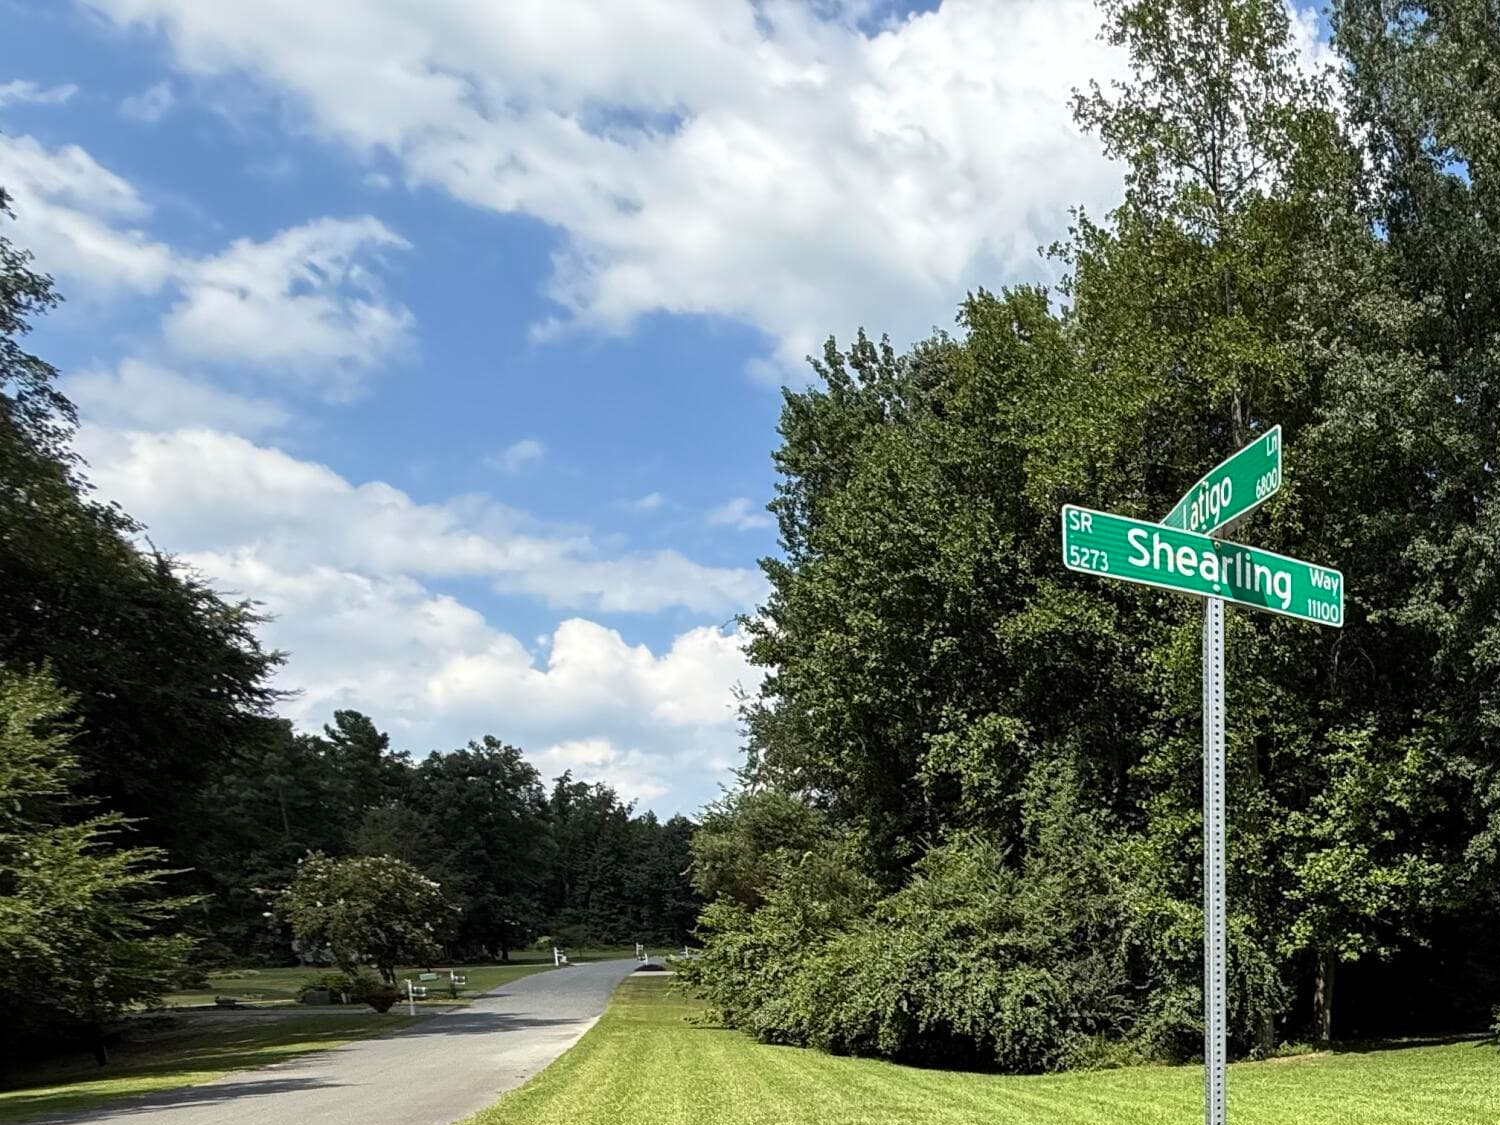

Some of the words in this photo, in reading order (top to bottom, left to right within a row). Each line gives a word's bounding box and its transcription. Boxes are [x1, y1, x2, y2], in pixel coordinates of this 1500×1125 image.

[1183, 476, 1232, 531] Latigo
[1266, 435, 1278, 456] Ln
[1255, 467, 1278, 500] 6800
[1069, 510, 1093, 534] SR
[1070, 544, 1109, 571] 5273
[1127, 528, 1292, 609] Shearling
[1309, 567, 1339, 597] Way
[1307, 598, 1339, 622] 11100
